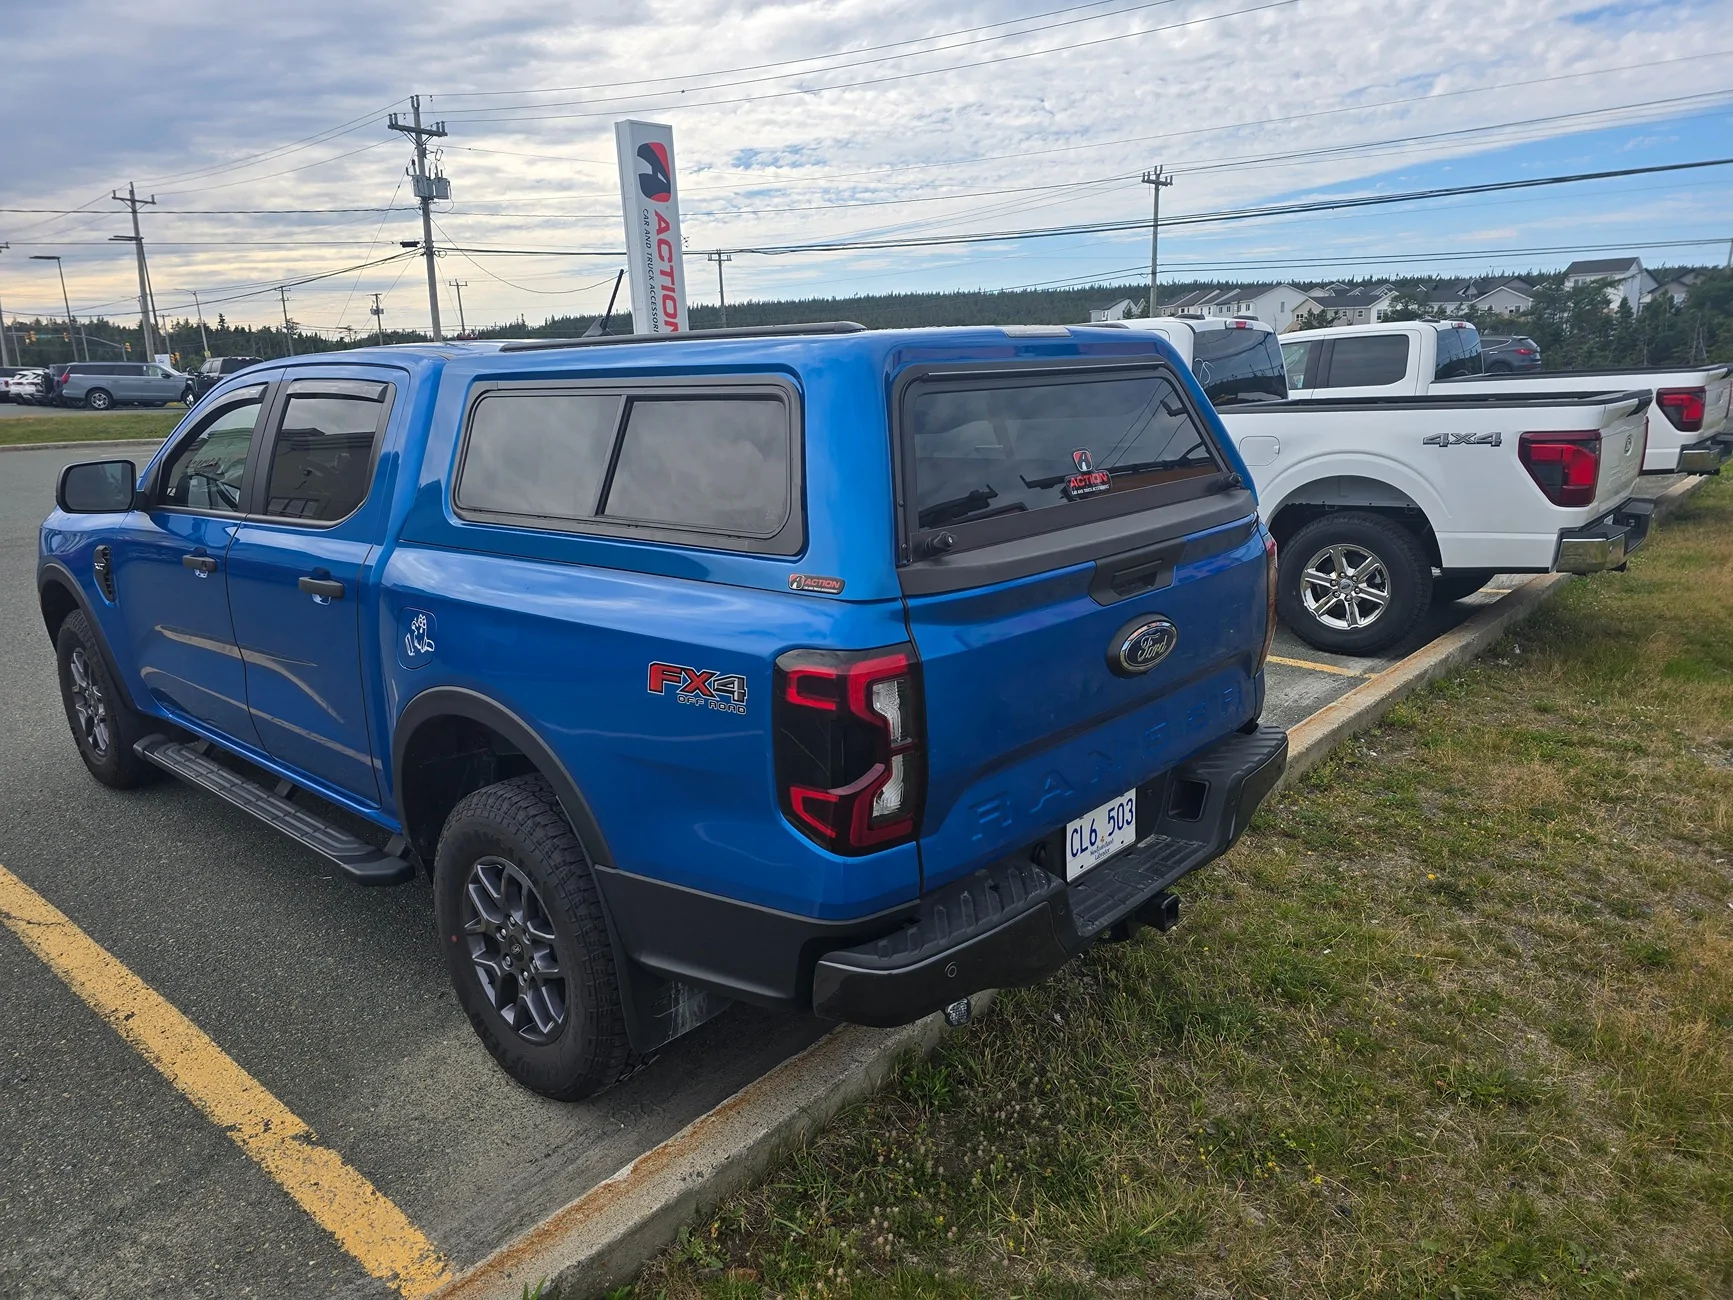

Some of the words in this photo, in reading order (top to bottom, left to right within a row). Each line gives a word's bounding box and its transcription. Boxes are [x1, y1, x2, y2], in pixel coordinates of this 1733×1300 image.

[644, 228, 652, 249] AND
[646, 252, 655, 282] TRUCK
[1422, 432, 1502, 447] 4X4
[1069, 472, 1108, 487] ACTION
[804, 578, 841, 589] ACTION
[1137, 632, 1168, 662] Ford
[647, 660, 748, 705] FX4
[677, 694, 705, 707] OFF
[708, 700, 747, 715] ROAD
[967, 682, 1244, 842] RANGER
[1070, 818, 1098, 858] CL6
[1107, 798, 1134, 837] 503
